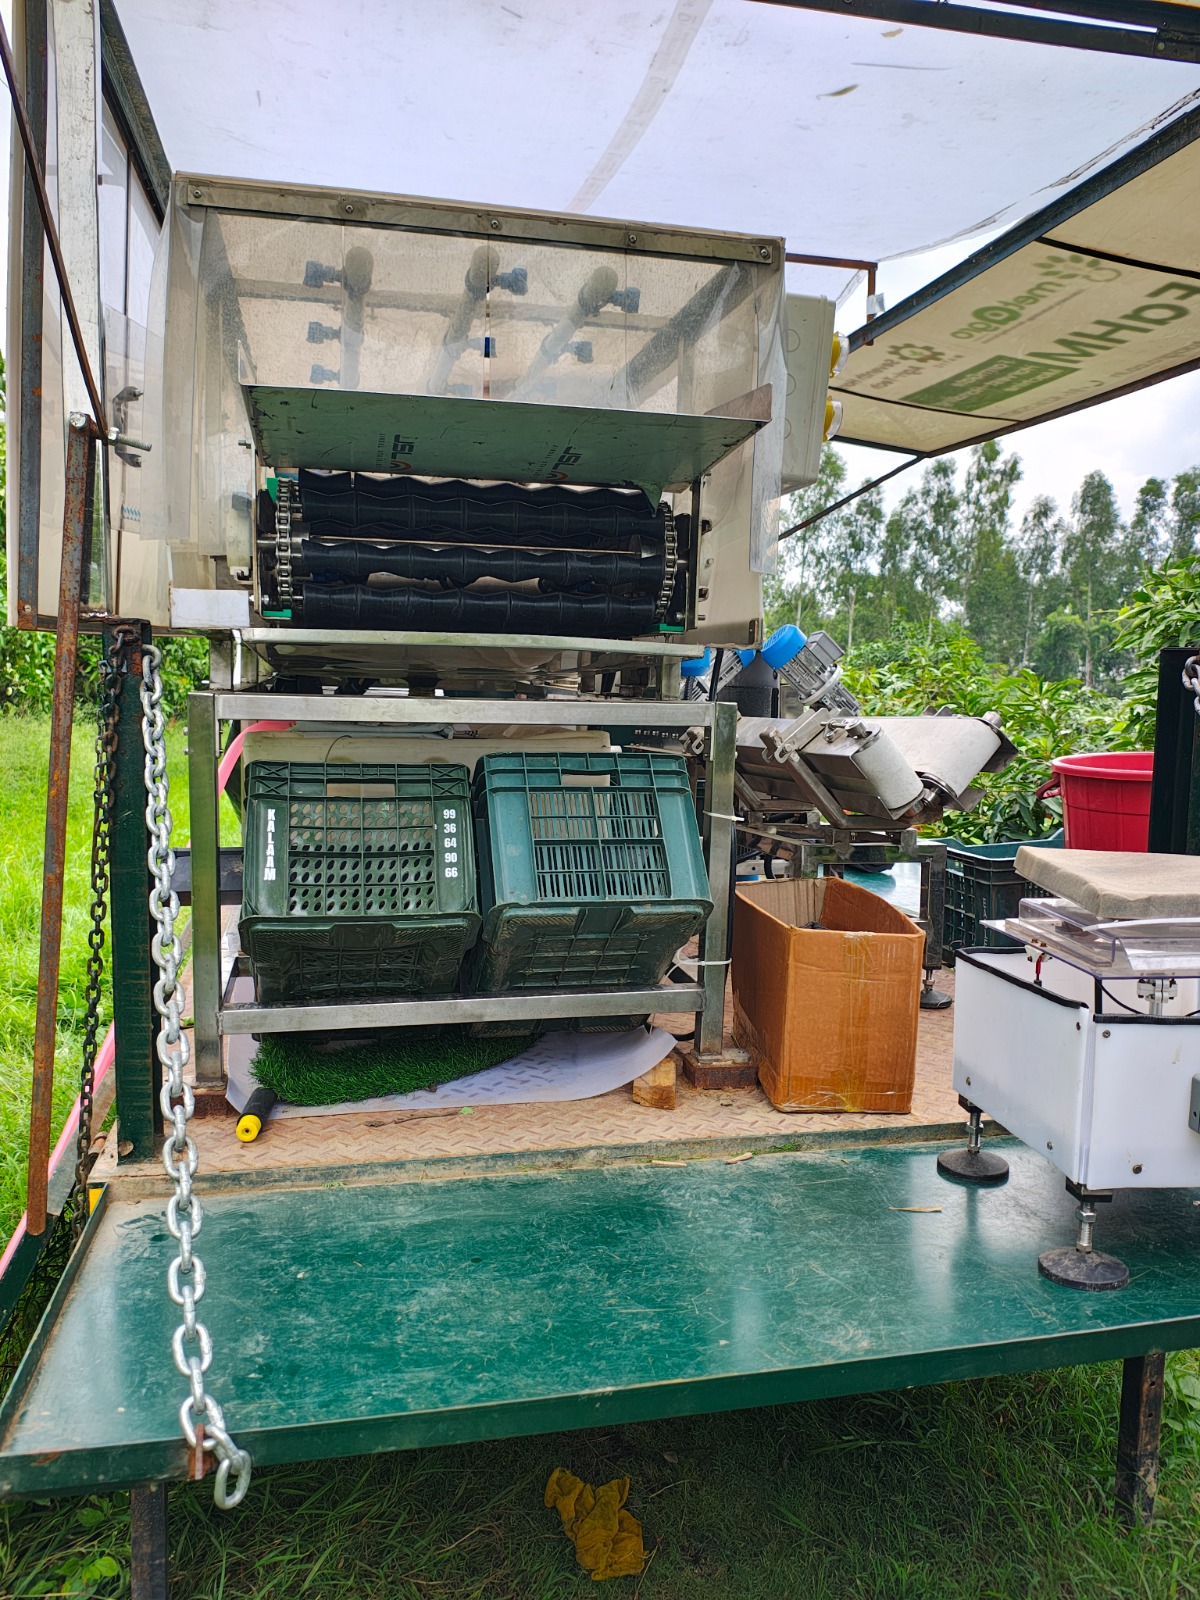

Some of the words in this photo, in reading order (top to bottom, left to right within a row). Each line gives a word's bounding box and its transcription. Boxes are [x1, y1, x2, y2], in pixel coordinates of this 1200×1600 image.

[443, 809, 456, 819] 99
[443, 823, 456, 833] 36
[264, 808, 276, 881] KALAAM
[444, 838, 457, 848] 64
[444, 852, 458, 863] 90
[444, 867, 458, 878] 66
